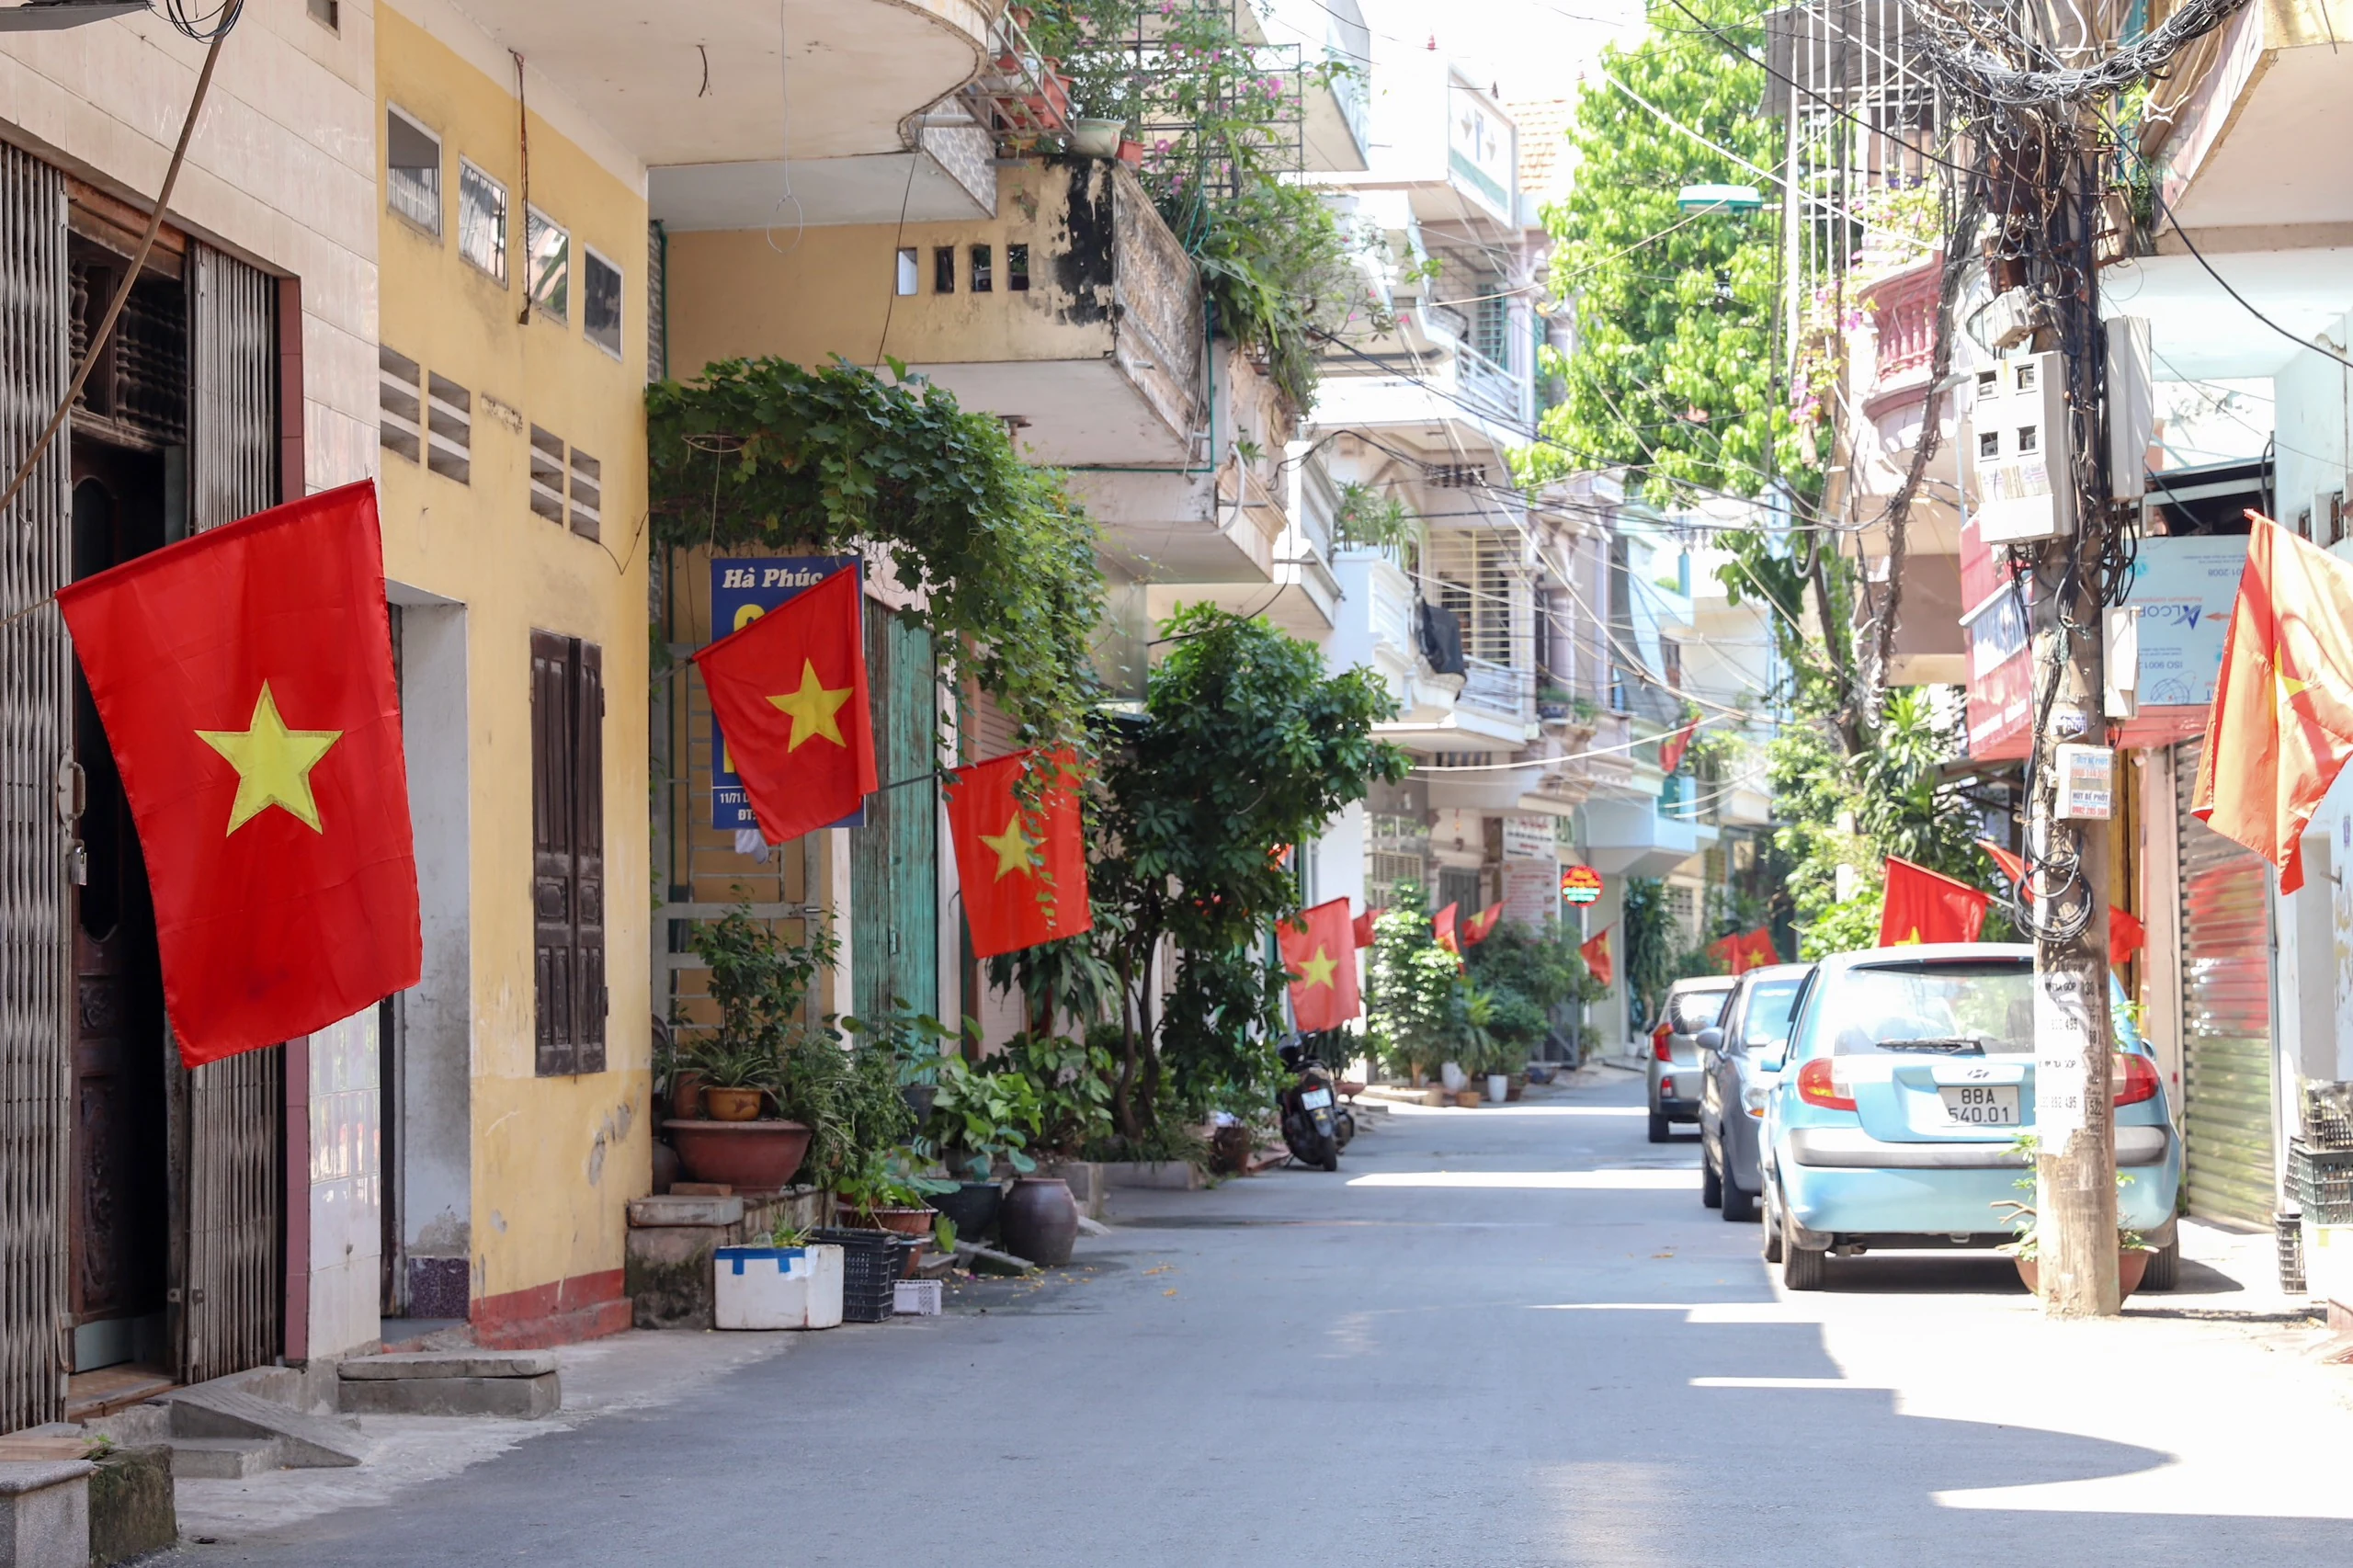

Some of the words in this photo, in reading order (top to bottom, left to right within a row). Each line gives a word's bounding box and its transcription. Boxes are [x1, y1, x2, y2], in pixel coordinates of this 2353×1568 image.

[722, 567, 756, 588] Hà
[762, 567, 824, 588] Phúc
[720, 792, 741, 804] 11/71
[1961, 1088, 1995, 1105] 88A
[1949, 1107, 2009, 1123] 540.01
